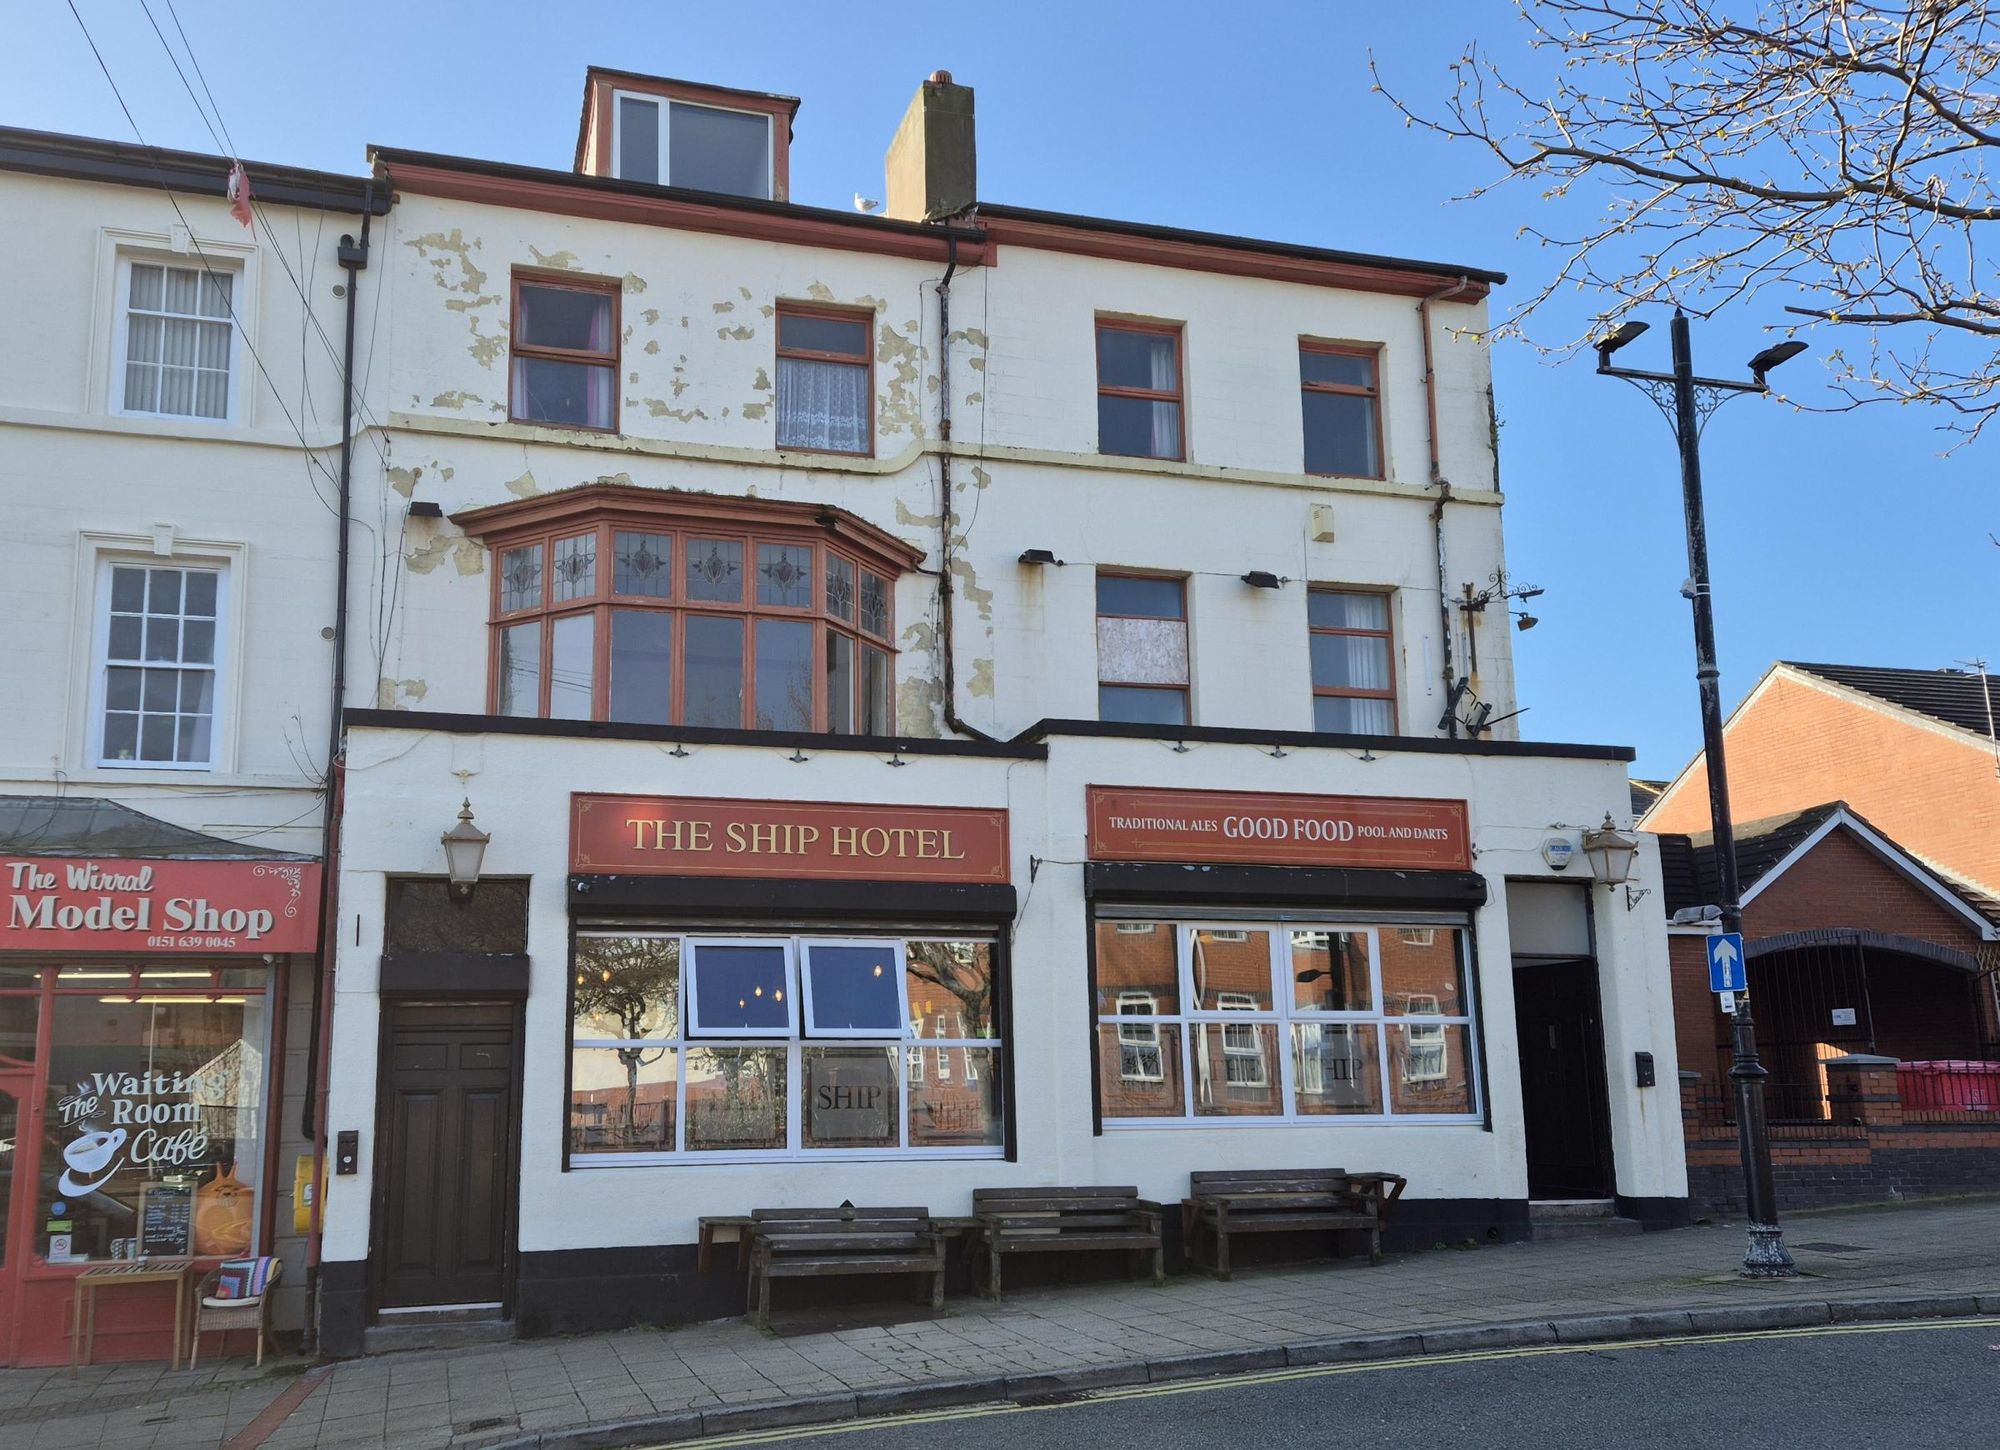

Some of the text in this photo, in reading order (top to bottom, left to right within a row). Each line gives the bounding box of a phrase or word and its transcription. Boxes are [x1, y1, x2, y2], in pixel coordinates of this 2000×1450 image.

[625, 818, 966, 861] THE SHIP HOTEL
[1108, 816, 1448, 842] TRADITIONAL ALES GOOD FOOD POOL AND DARTS
[6, 861, 154, 892] The Wirral
[7, 894, 274, 940] Model Shop
[147, 935, 236, 948] 0151 639 0045
[91, 1071, 228, 1099] Waiting
[817, 1085, 881, 1110] SHIP
[58, 1096, 98, 1124] The
[110, 1099, 202, 1125] Room
[130, 1126, 208, 1165] Café
